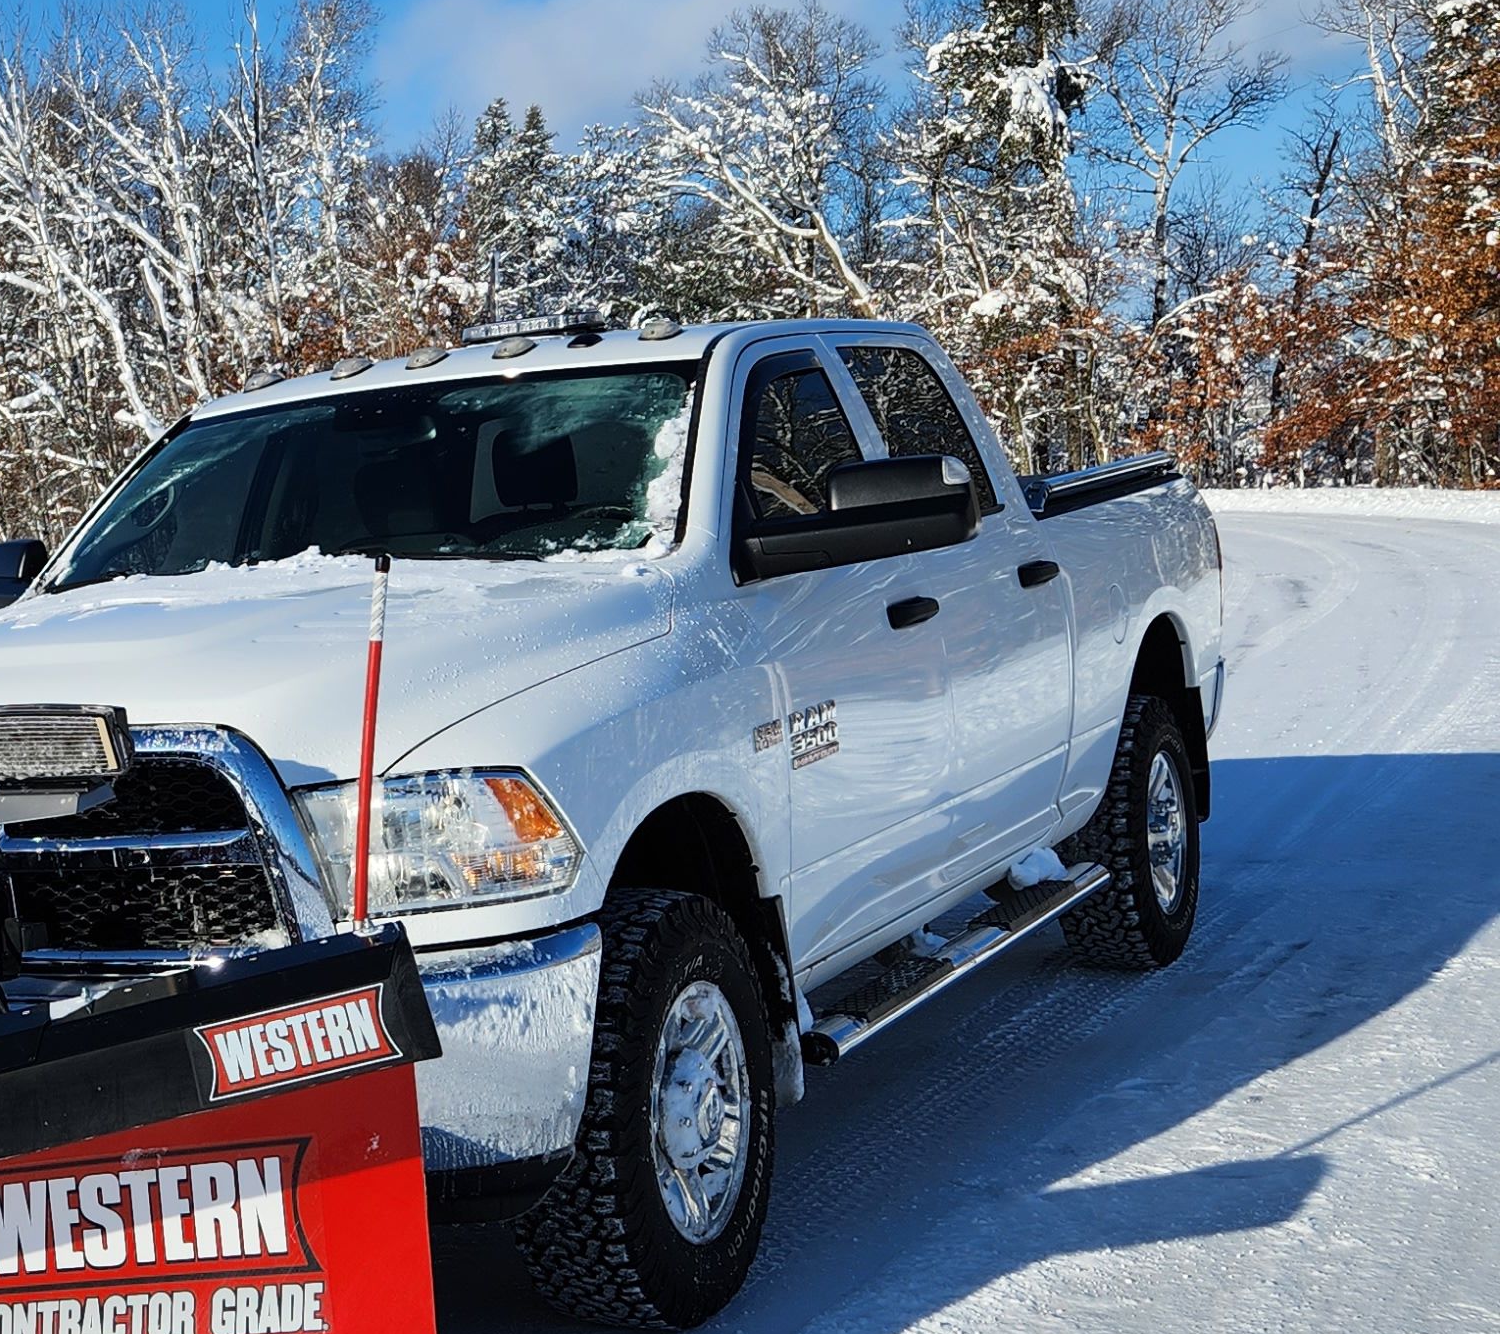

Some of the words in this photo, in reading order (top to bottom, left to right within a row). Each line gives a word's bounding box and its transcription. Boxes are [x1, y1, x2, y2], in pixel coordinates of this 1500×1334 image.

[788, 699, 836, 734] RAM
[790, 721, 838, 755] 3500
[214, 998, 381, 1085] WESTERN
